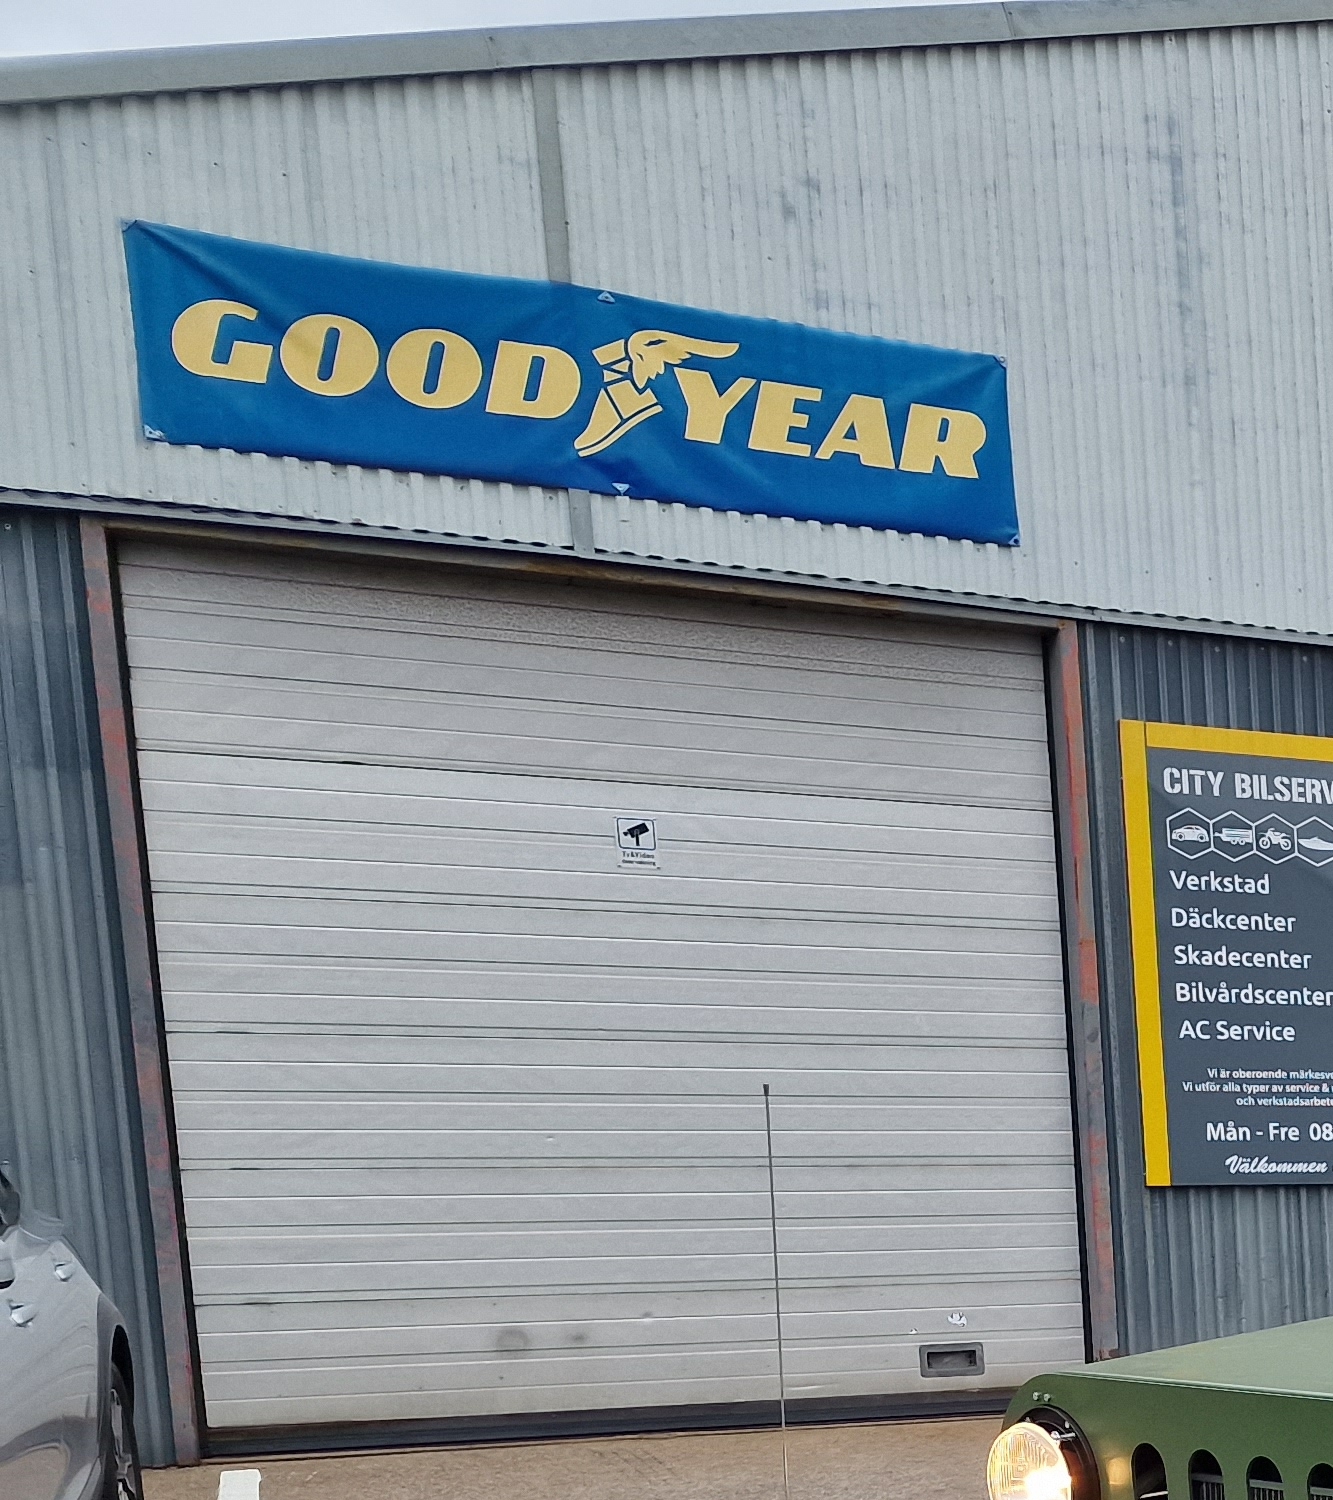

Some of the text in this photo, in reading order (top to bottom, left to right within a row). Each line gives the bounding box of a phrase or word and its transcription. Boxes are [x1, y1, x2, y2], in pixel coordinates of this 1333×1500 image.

[1163, 767, 1224, 797] CITY
[1169, 870, 1270, 894] Verkstad
[1171, 907, 1296, 932] Däckcenter
[1174, 944, 1312, 969] Skadecenter
[1175, 981, 1333, 1006] Bilvårdscenter
[1179, 1020, 1296, 1041] AC Service
[1207, 1068, 1218, 1079] Vi
[1219, 1068, 1230, 1079] är
[1182, 1082, 1193, 1092] Vi
[1195, 1082, 1221, 1092] utför
[1222, 1082, 1240, 1092] alla
[1242, 1082, 1270, 1094] typer
[1271, 1084, 1283, 1093] av
[1285, 1083, 1320, 1093] service
[1321, 1083, 1330, 1093] &
[1236, 1096, 1255, 1106] och
[1206, 1120, 1251, 1142] Mån
[1268, 1122, 1300, 1141] Fre
[1309, 1122, 1333, 1141] 08
[1224, 1155, 1328, 1174] Välkommen
